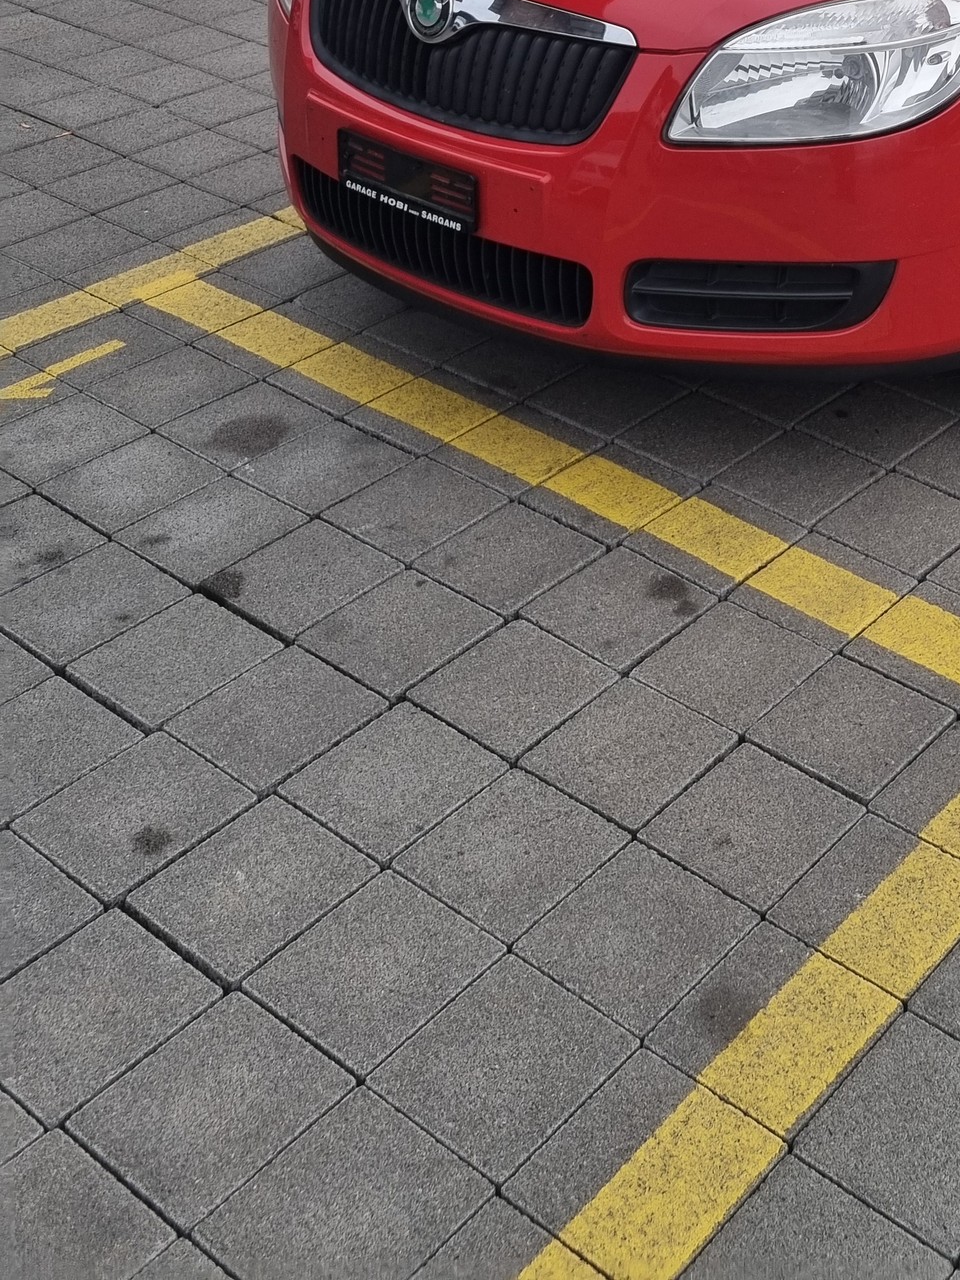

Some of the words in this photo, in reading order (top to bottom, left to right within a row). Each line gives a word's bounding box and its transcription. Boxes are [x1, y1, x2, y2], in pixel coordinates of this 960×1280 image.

[346, 180, 377, 199] GARAGE
[380, 194, 408, 211] HOBI
[421, 210, 462, 231] SARGANS
